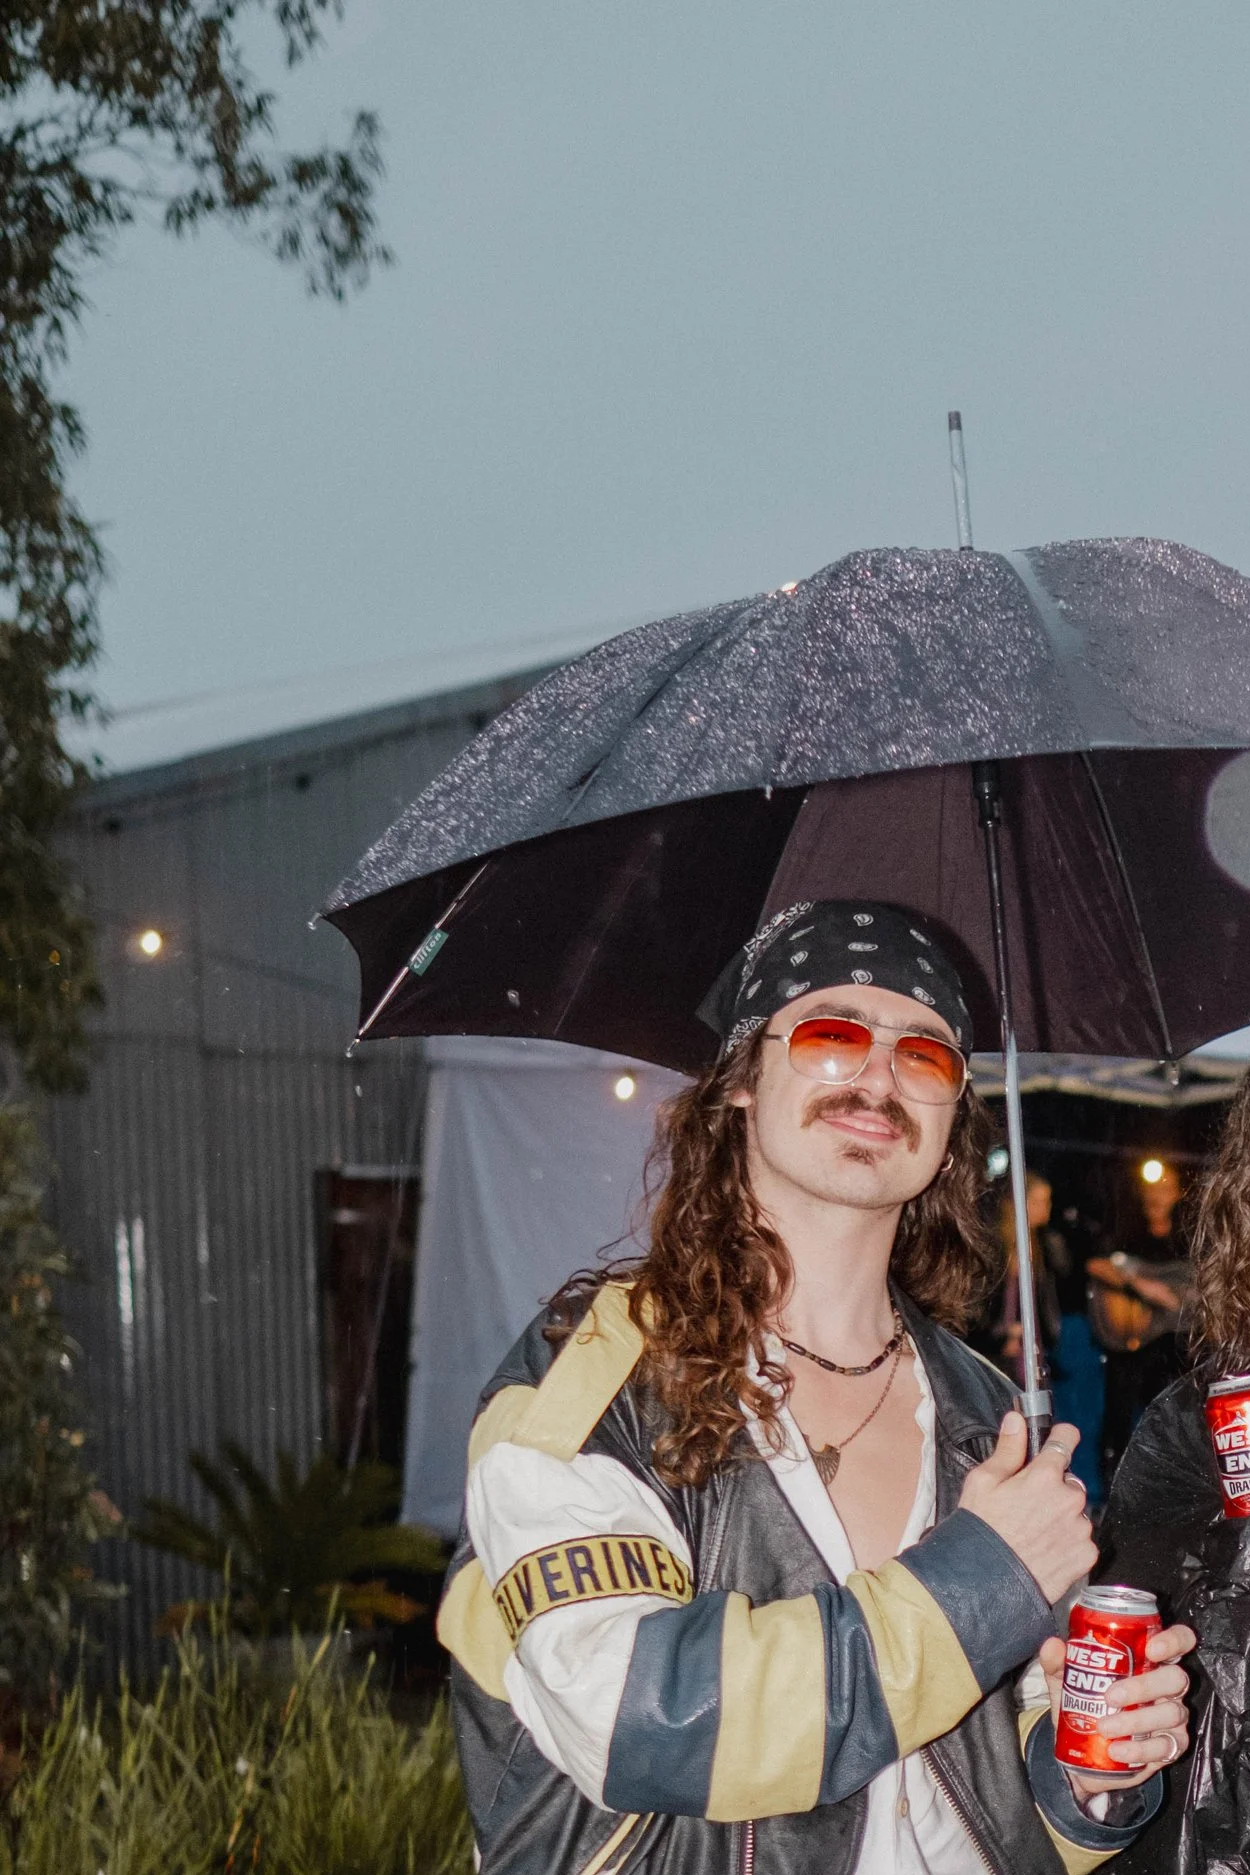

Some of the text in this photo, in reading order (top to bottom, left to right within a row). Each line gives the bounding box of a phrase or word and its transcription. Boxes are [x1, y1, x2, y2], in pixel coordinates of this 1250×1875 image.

[496, 1541, 686, 1641] OLVERINES
[1066, 1643, 1124, 1670] WEST
[1066, 1668, 1113, 1692] END
[1064, 1692, 1105, 1715] DRAUGH
